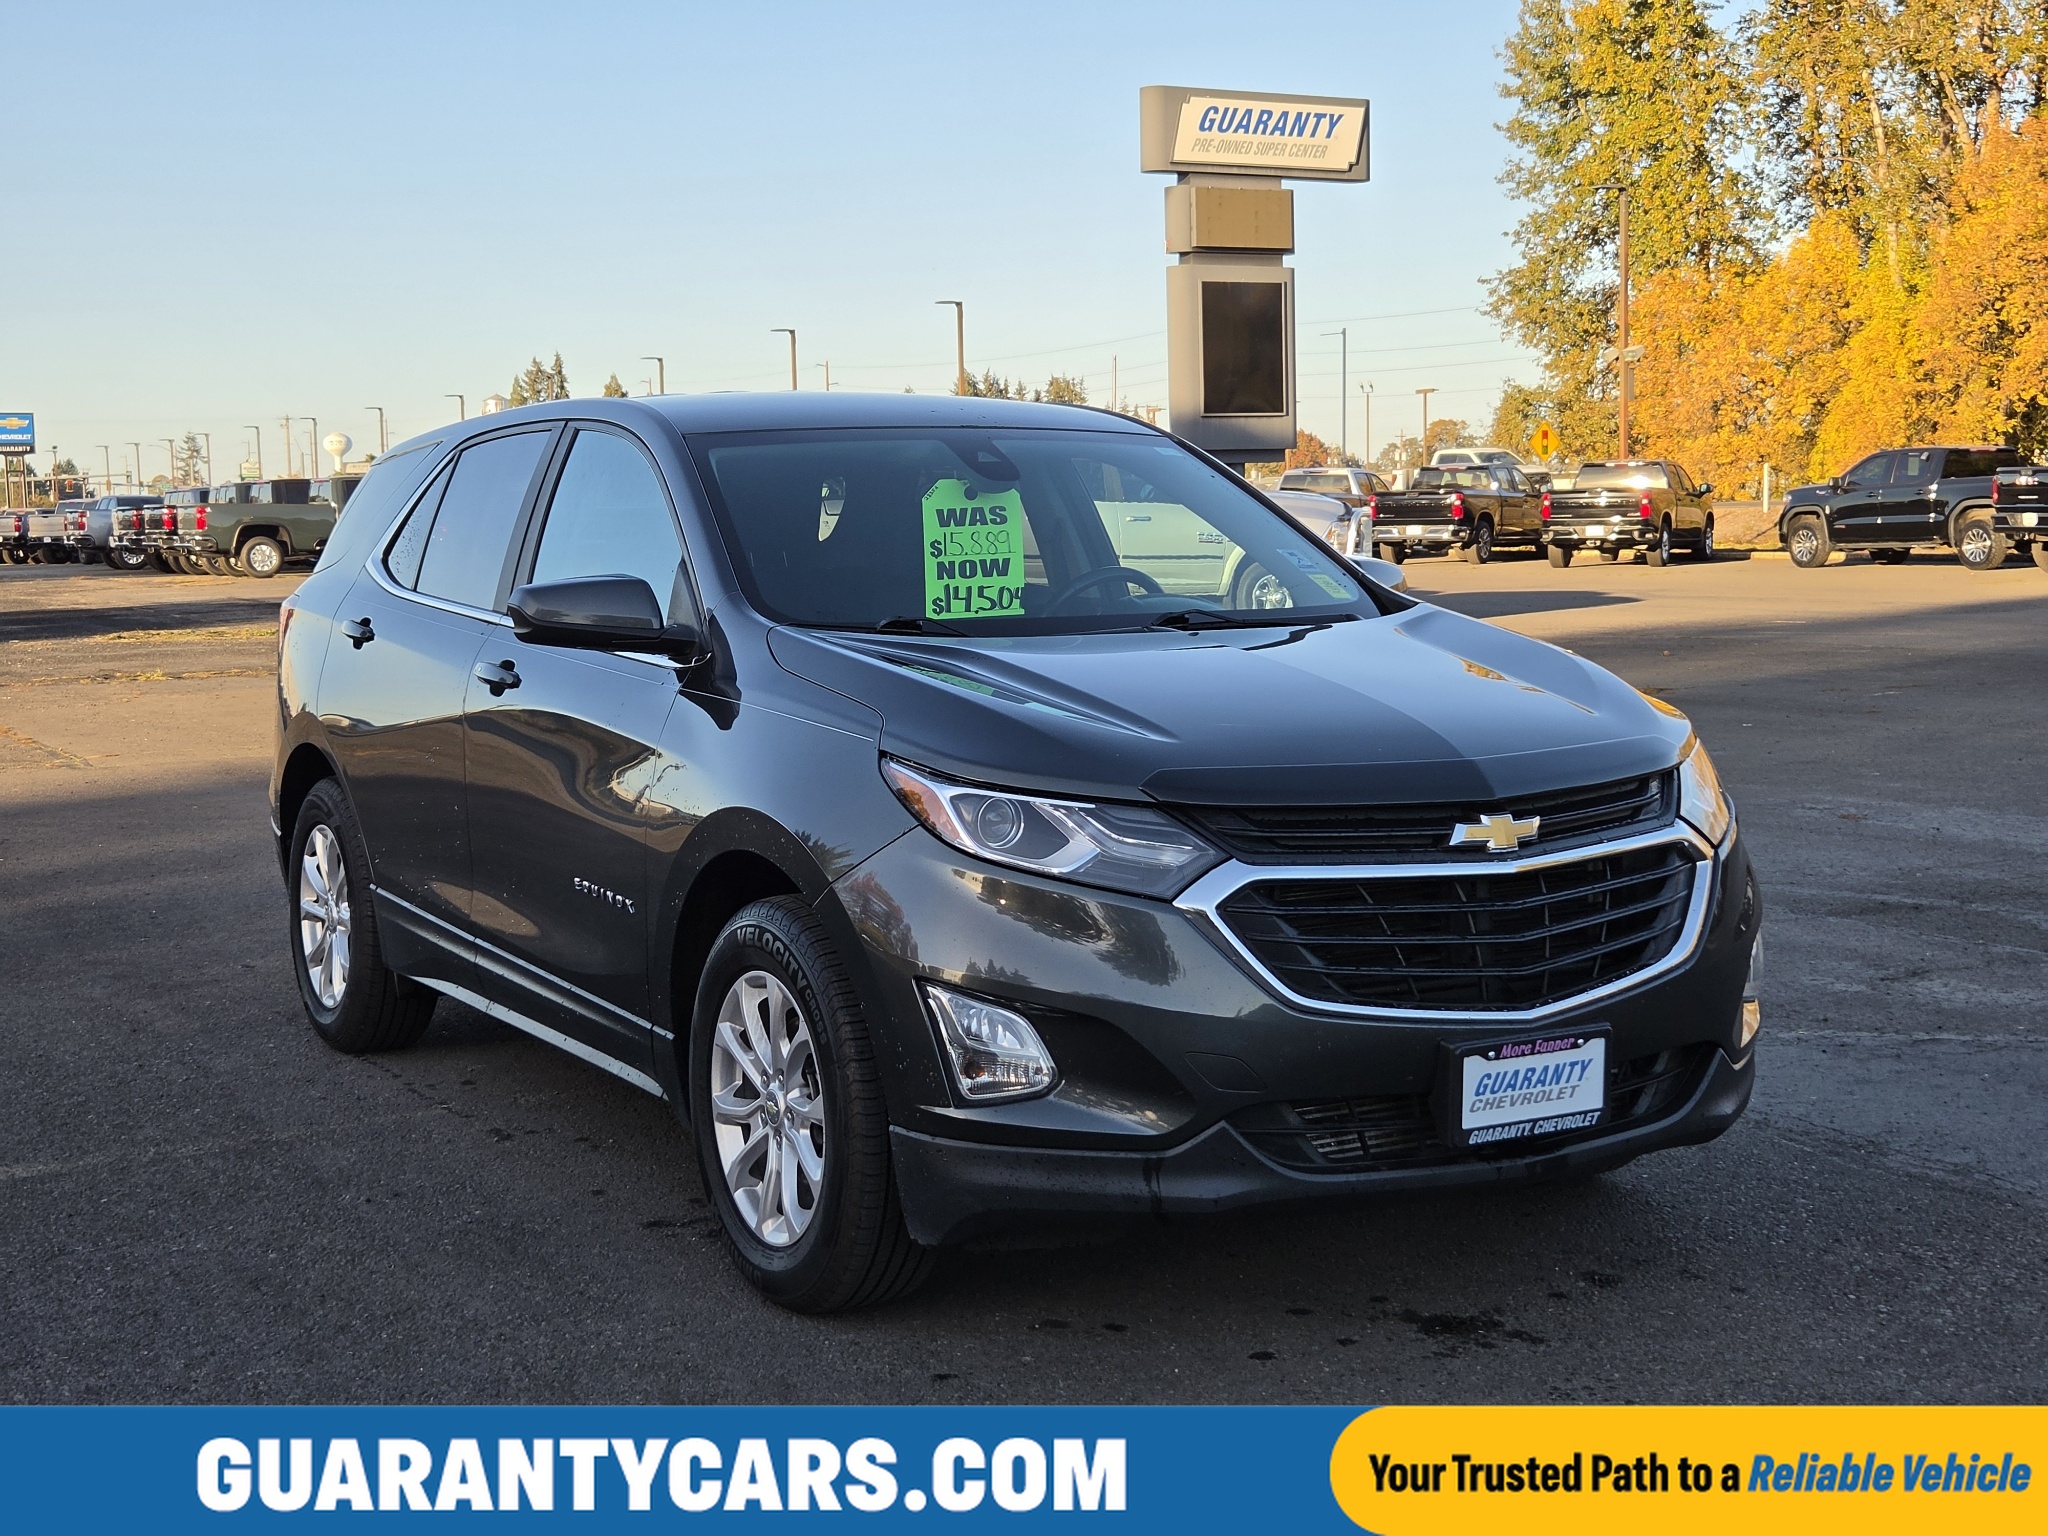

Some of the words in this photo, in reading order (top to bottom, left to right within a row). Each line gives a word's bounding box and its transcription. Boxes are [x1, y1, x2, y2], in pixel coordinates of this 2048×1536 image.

[1198, 105, 1344, 139] GUARANTY
[1191, 138, 1254, 156] PRE-OWNED
[1253, 141, 1288, 157] SUPER
[1287, 143, 1329, 159] CENTER
[935, 505, 1008, 528] WAS
[936, 557, 1011, 580] NOW
[573, 877, 635, 914] EQUINOX
[736, 927, 807, 992] VELOCITY
[804, 989, 828, 1045] CROSS
[1499, 1043, 1532, 1058] More
[1474, 1058, 1593, 1097] GUARANTY
[1469, 1084, 1580, 1113] CHEVROLET
[1468, 1122, 1531, 1145] GUARANTY
[1534, 1111, 1601, 1135] CHEVROLET
